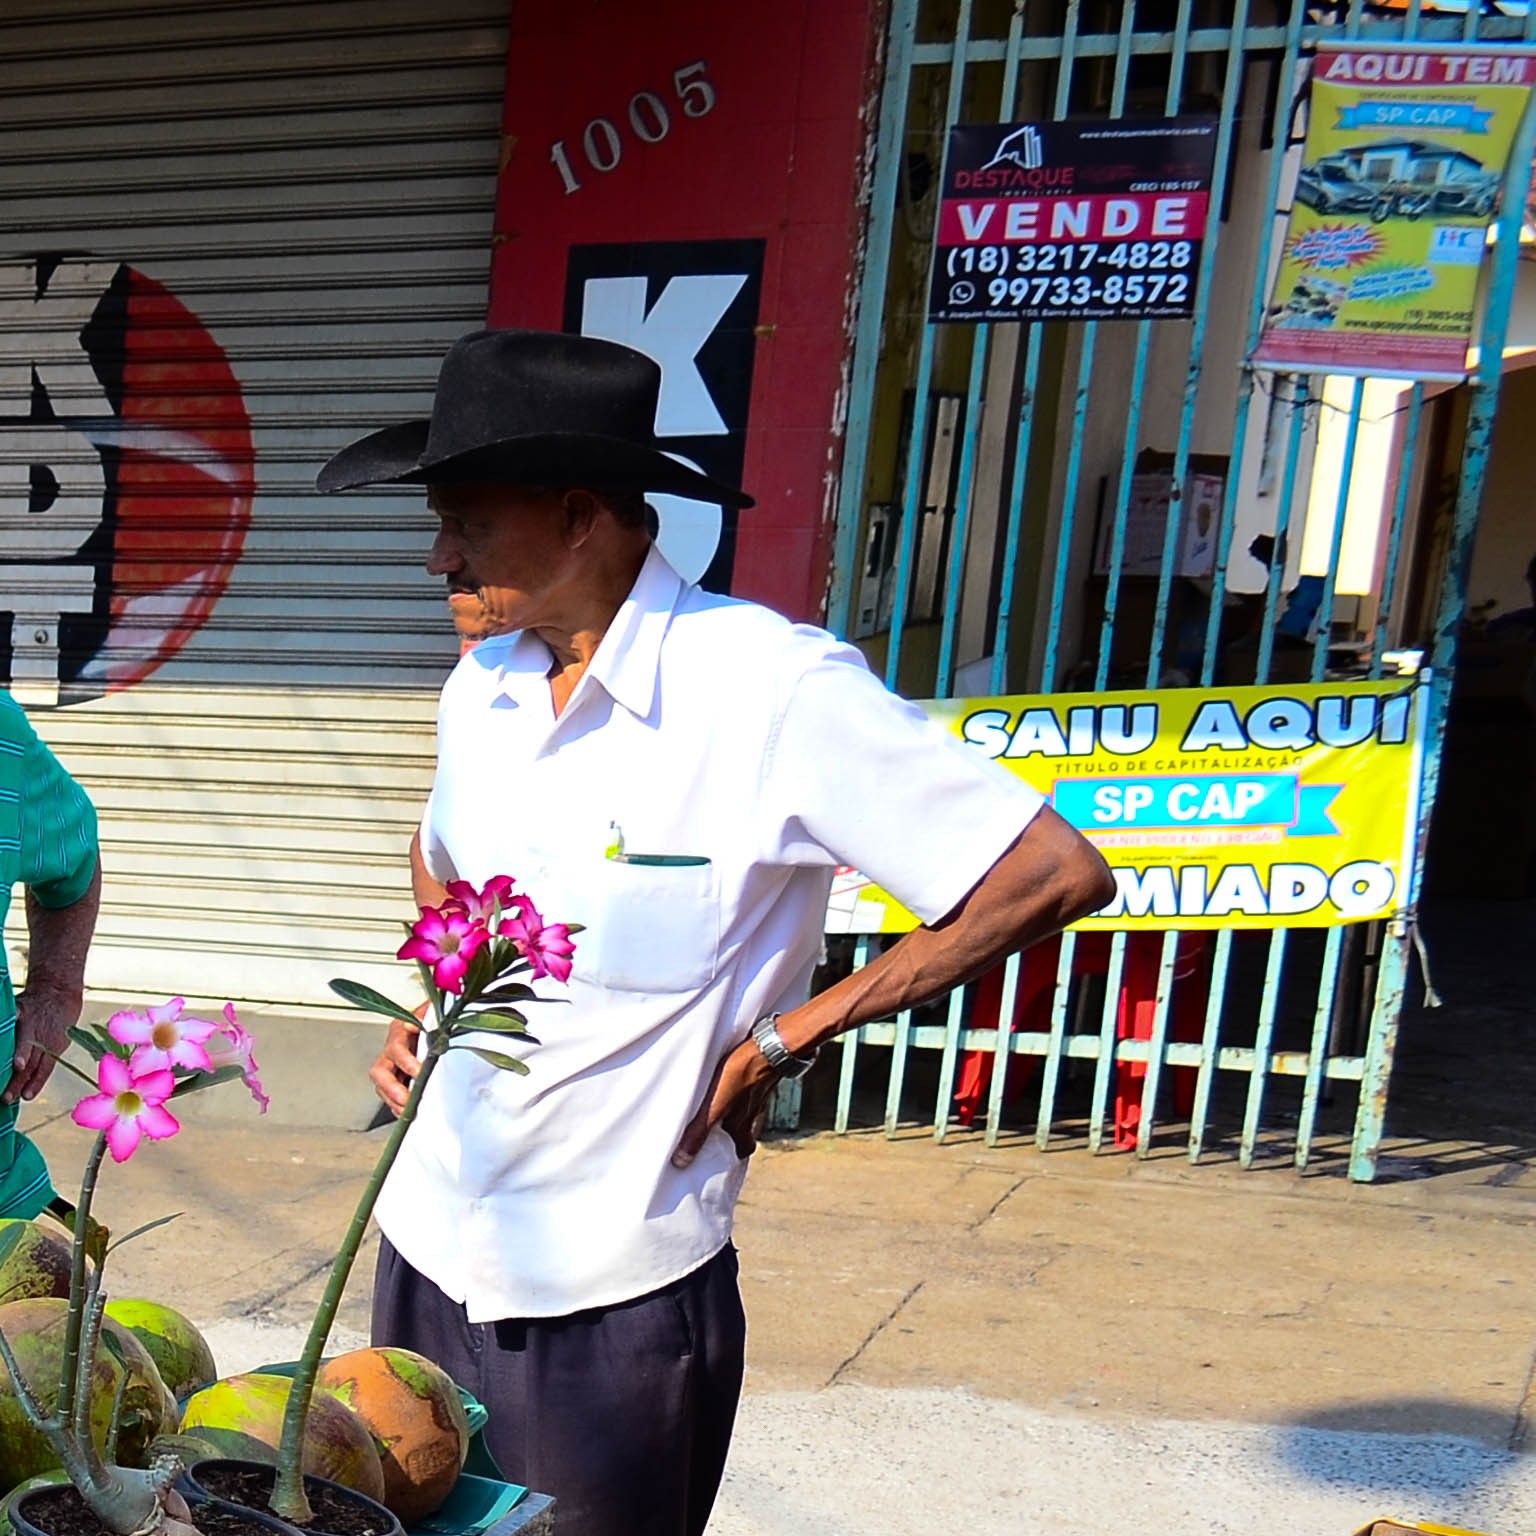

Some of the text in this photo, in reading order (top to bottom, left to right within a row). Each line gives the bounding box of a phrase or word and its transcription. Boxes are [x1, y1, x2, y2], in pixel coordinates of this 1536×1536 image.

[1325, 54, 1526, 83] AQUI TEM
[549, 60, 717, 196] 1005
[1376, 106, 1456, 125] SP CAP
[954, 167, 1075, 190] DESTAQUE
[956, 198, 1189, 241] VENDE
[946, 241, 1191, 277] (18) 3217-4828
[988, 274, 1189, 306] 99733-8572
[962, 693, 1411, 759] SAIU AQUI
[1055, 755, 1304, 774] TÍTULO DE CAPITALIZAÇÃO
[1092, 781, 1266, 823] SP CAP
[1088, 860, 1395, 919] MIADO
